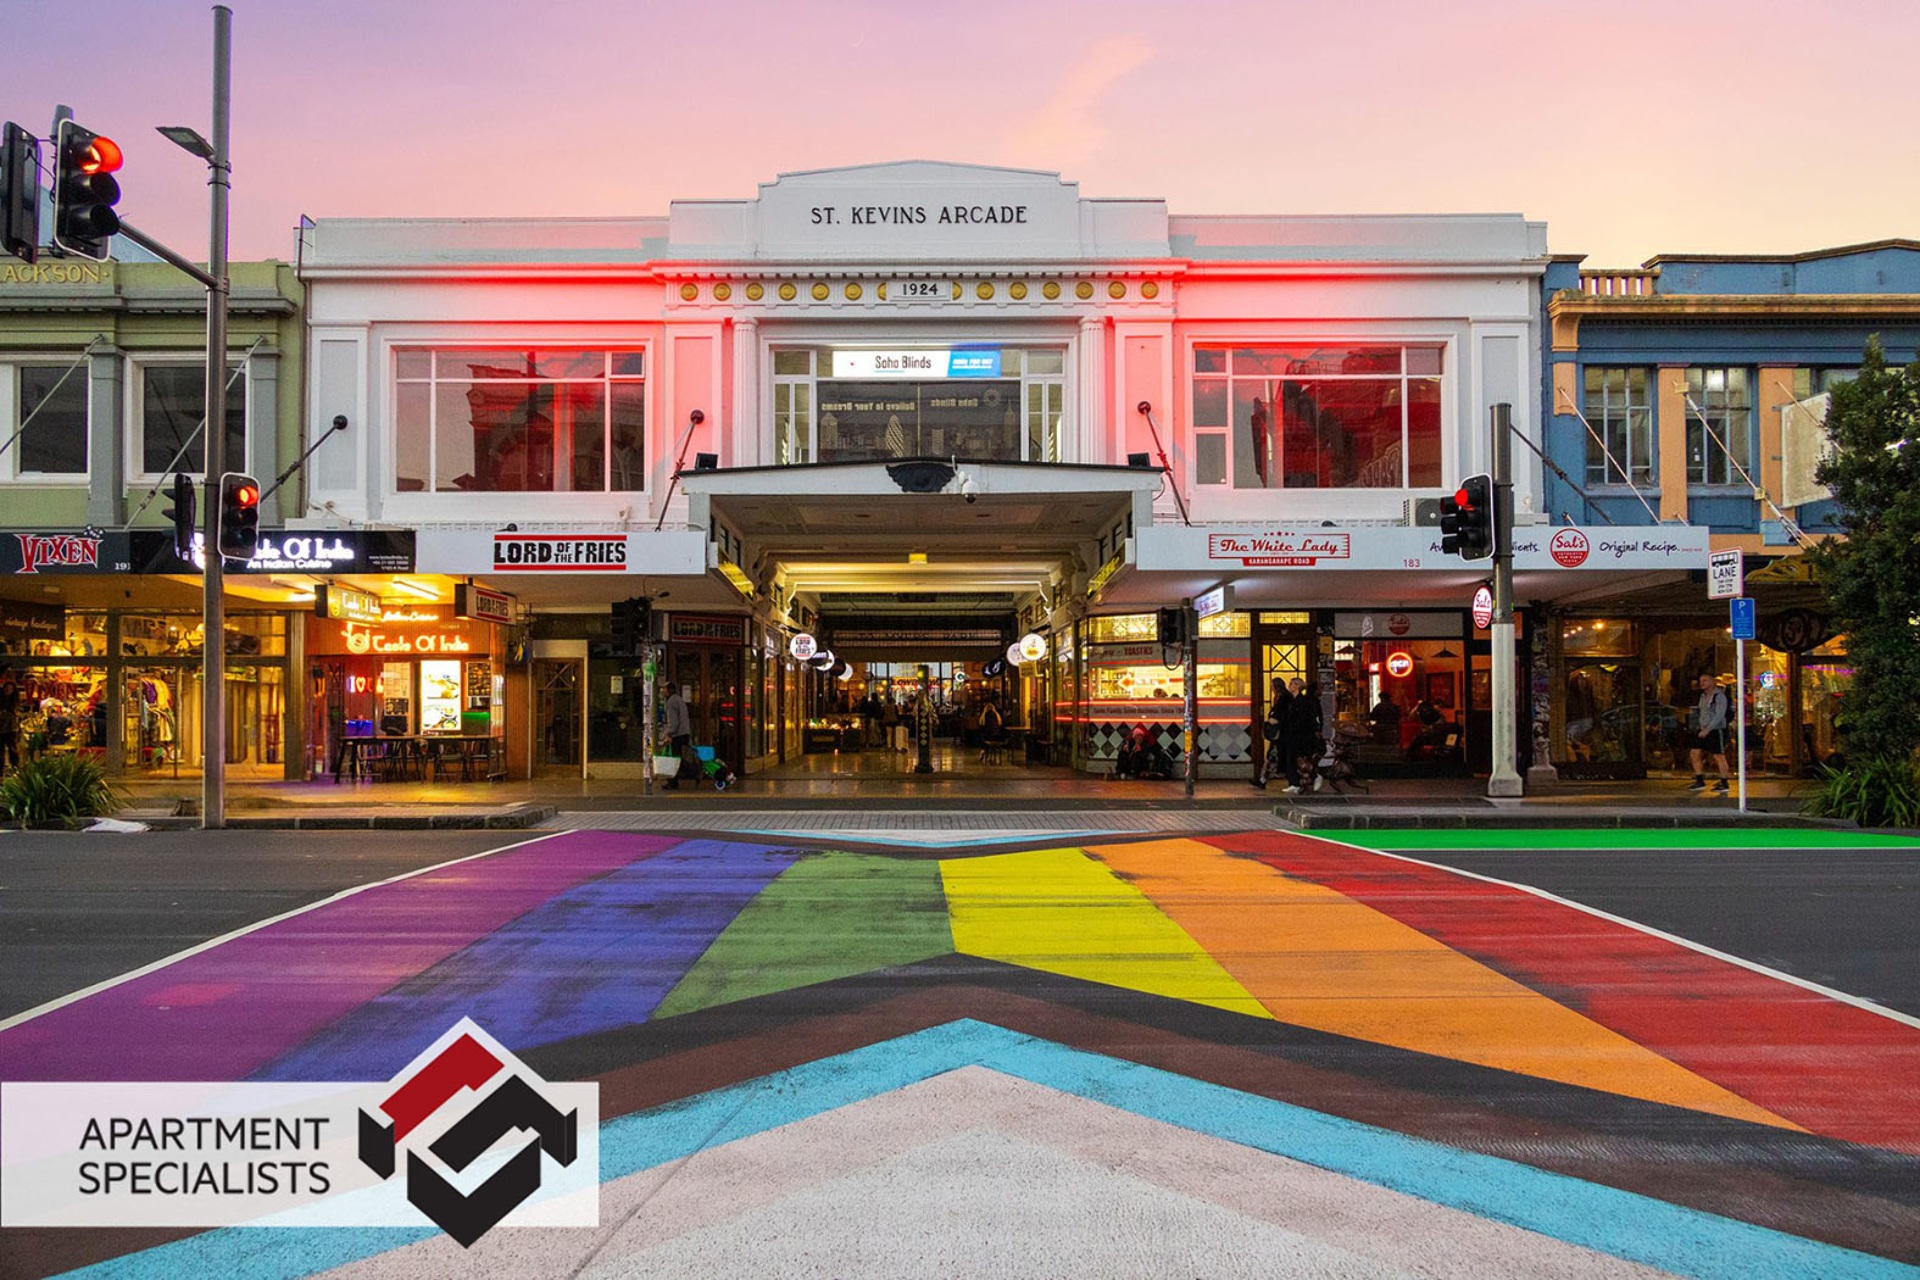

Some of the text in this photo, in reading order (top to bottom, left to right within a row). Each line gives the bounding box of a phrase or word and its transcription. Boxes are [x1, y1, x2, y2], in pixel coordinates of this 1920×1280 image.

[811, 206, 1027, 224] ST. KEVINS ARCADE
[903, 283, 938, 295] 1924
[875, 355, 932, 369] Soho Blinds
[284, 538, 312, 559] Of
[315, 538, 355, 560] India
[556, 542, 571, 552] OF
[1220, 539, 1338, 555] The White Lady
[1556, 535, 1585, 549] Sal's
[1599, 541, 1639, 558] Original
[14, 534, 103, 573] VIXEN
[494, 542, 626, 563] LORD FRIES
[554, 553, 573, 563] THE
[1403, 559, 1420, 568] 183
[1713, 566, 1737, 580] LANE
[674, 621, 741, 638] LORD FRIES
[415, 635, 435, 652] Of
